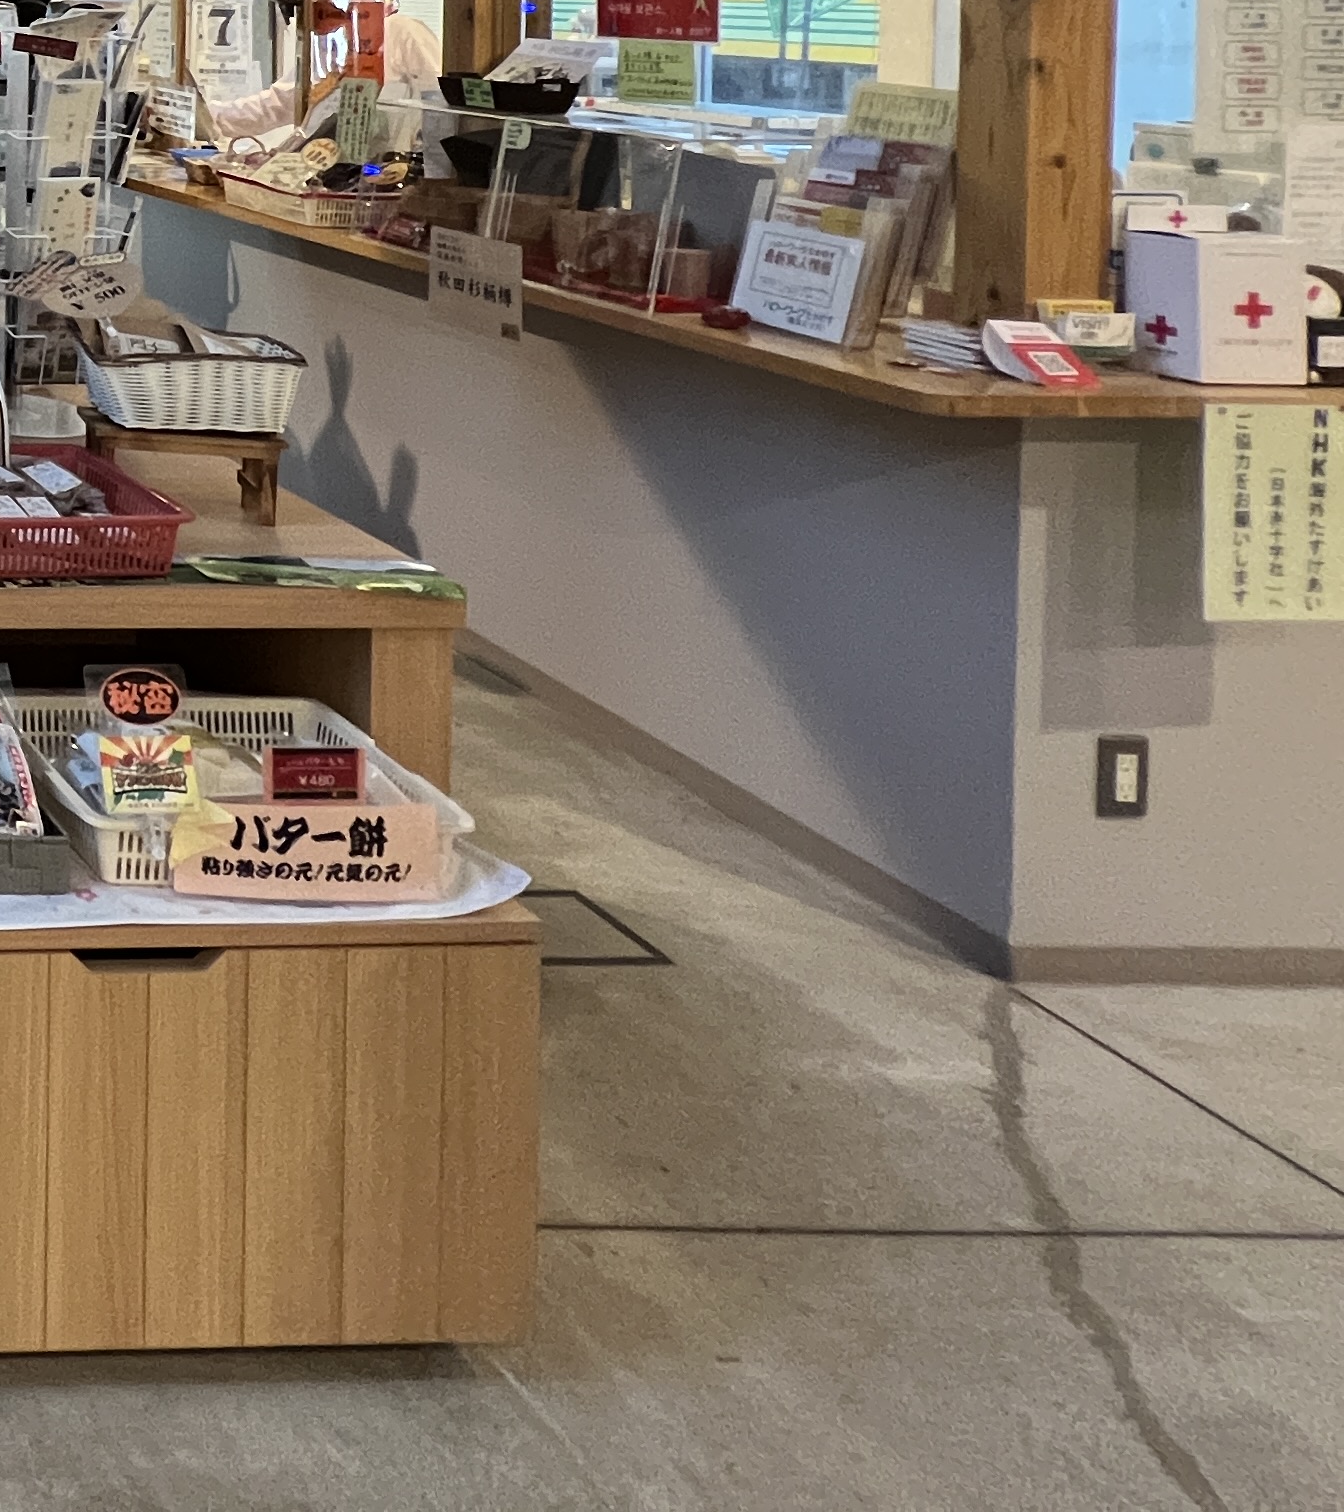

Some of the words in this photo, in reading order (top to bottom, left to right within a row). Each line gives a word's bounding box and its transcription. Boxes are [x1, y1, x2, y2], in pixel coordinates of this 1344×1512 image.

[208, 9, 235, 47] 7
[94, 285, 126, 303] 500
[299, 775, 335, 787] ¥480
[230, 815, 388, 858] バター餅
[201, 856, 412, 885] 粘り強さの元！元気の元！
